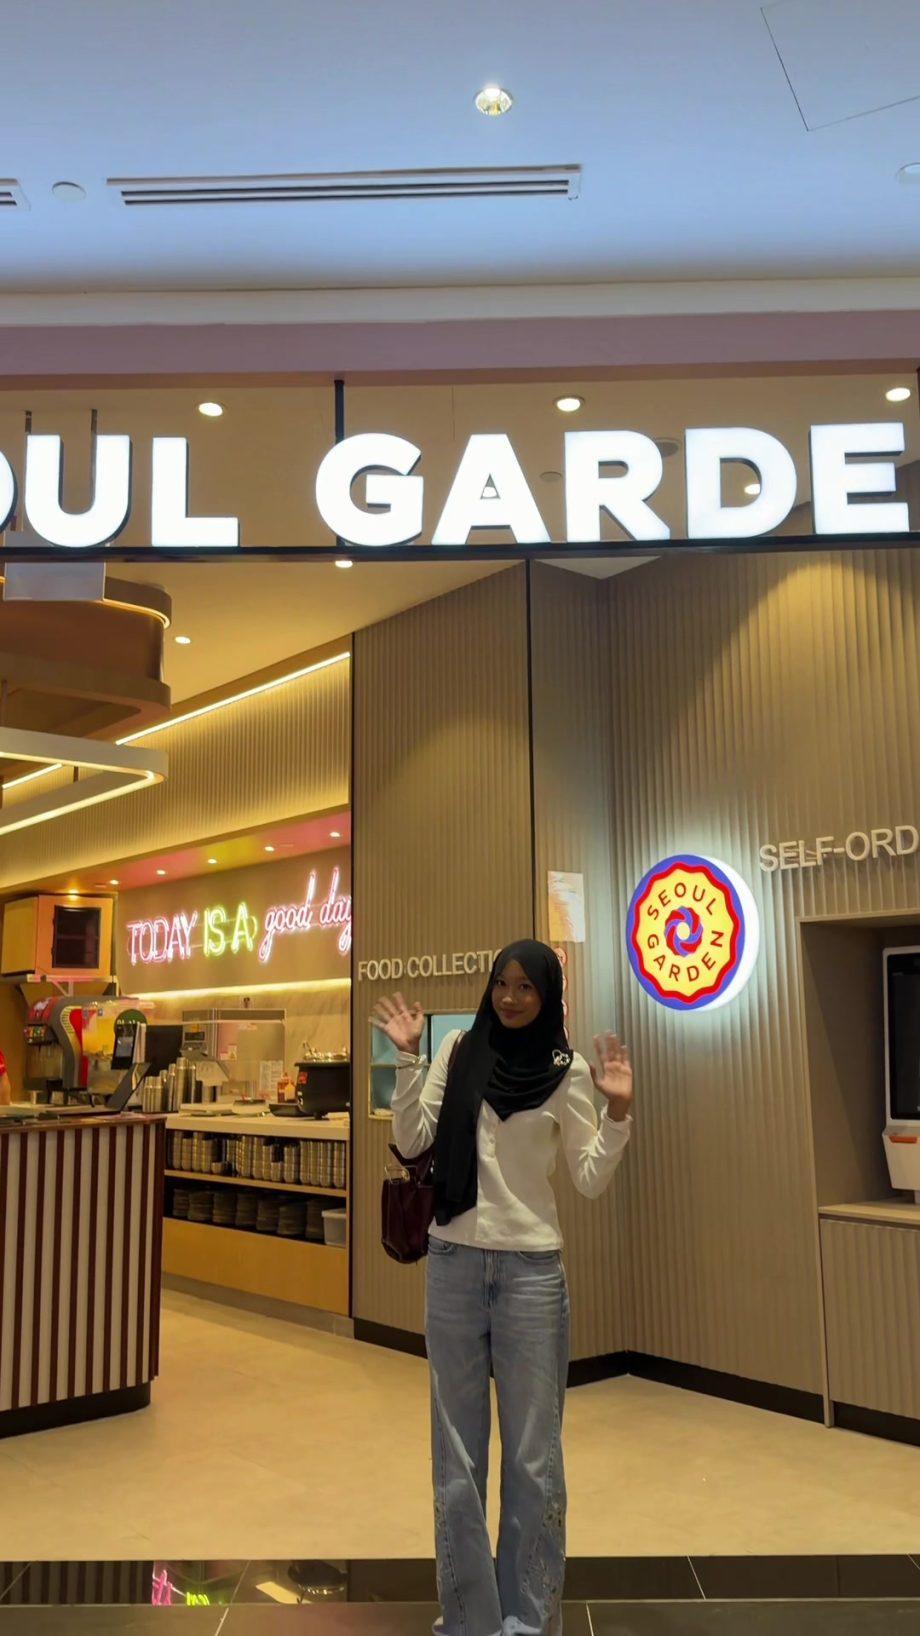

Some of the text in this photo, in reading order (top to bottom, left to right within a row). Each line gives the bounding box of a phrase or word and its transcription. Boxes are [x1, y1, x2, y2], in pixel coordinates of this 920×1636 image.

[0, 422, 910, 548] UL GARDE
[759, 825, 919, 872] SELF-ORD
[126, 910, 198, 966] TODAY
[203, 906, 227, 957] IS
[230, 901, 254, 955] A
[258, 869, 316, 964] good
[647, 882, 717, 920] SEOUL
[358, 949, 502, 981] FOOD COLLECTI
[647, 930, 724, 982] GARDEN
